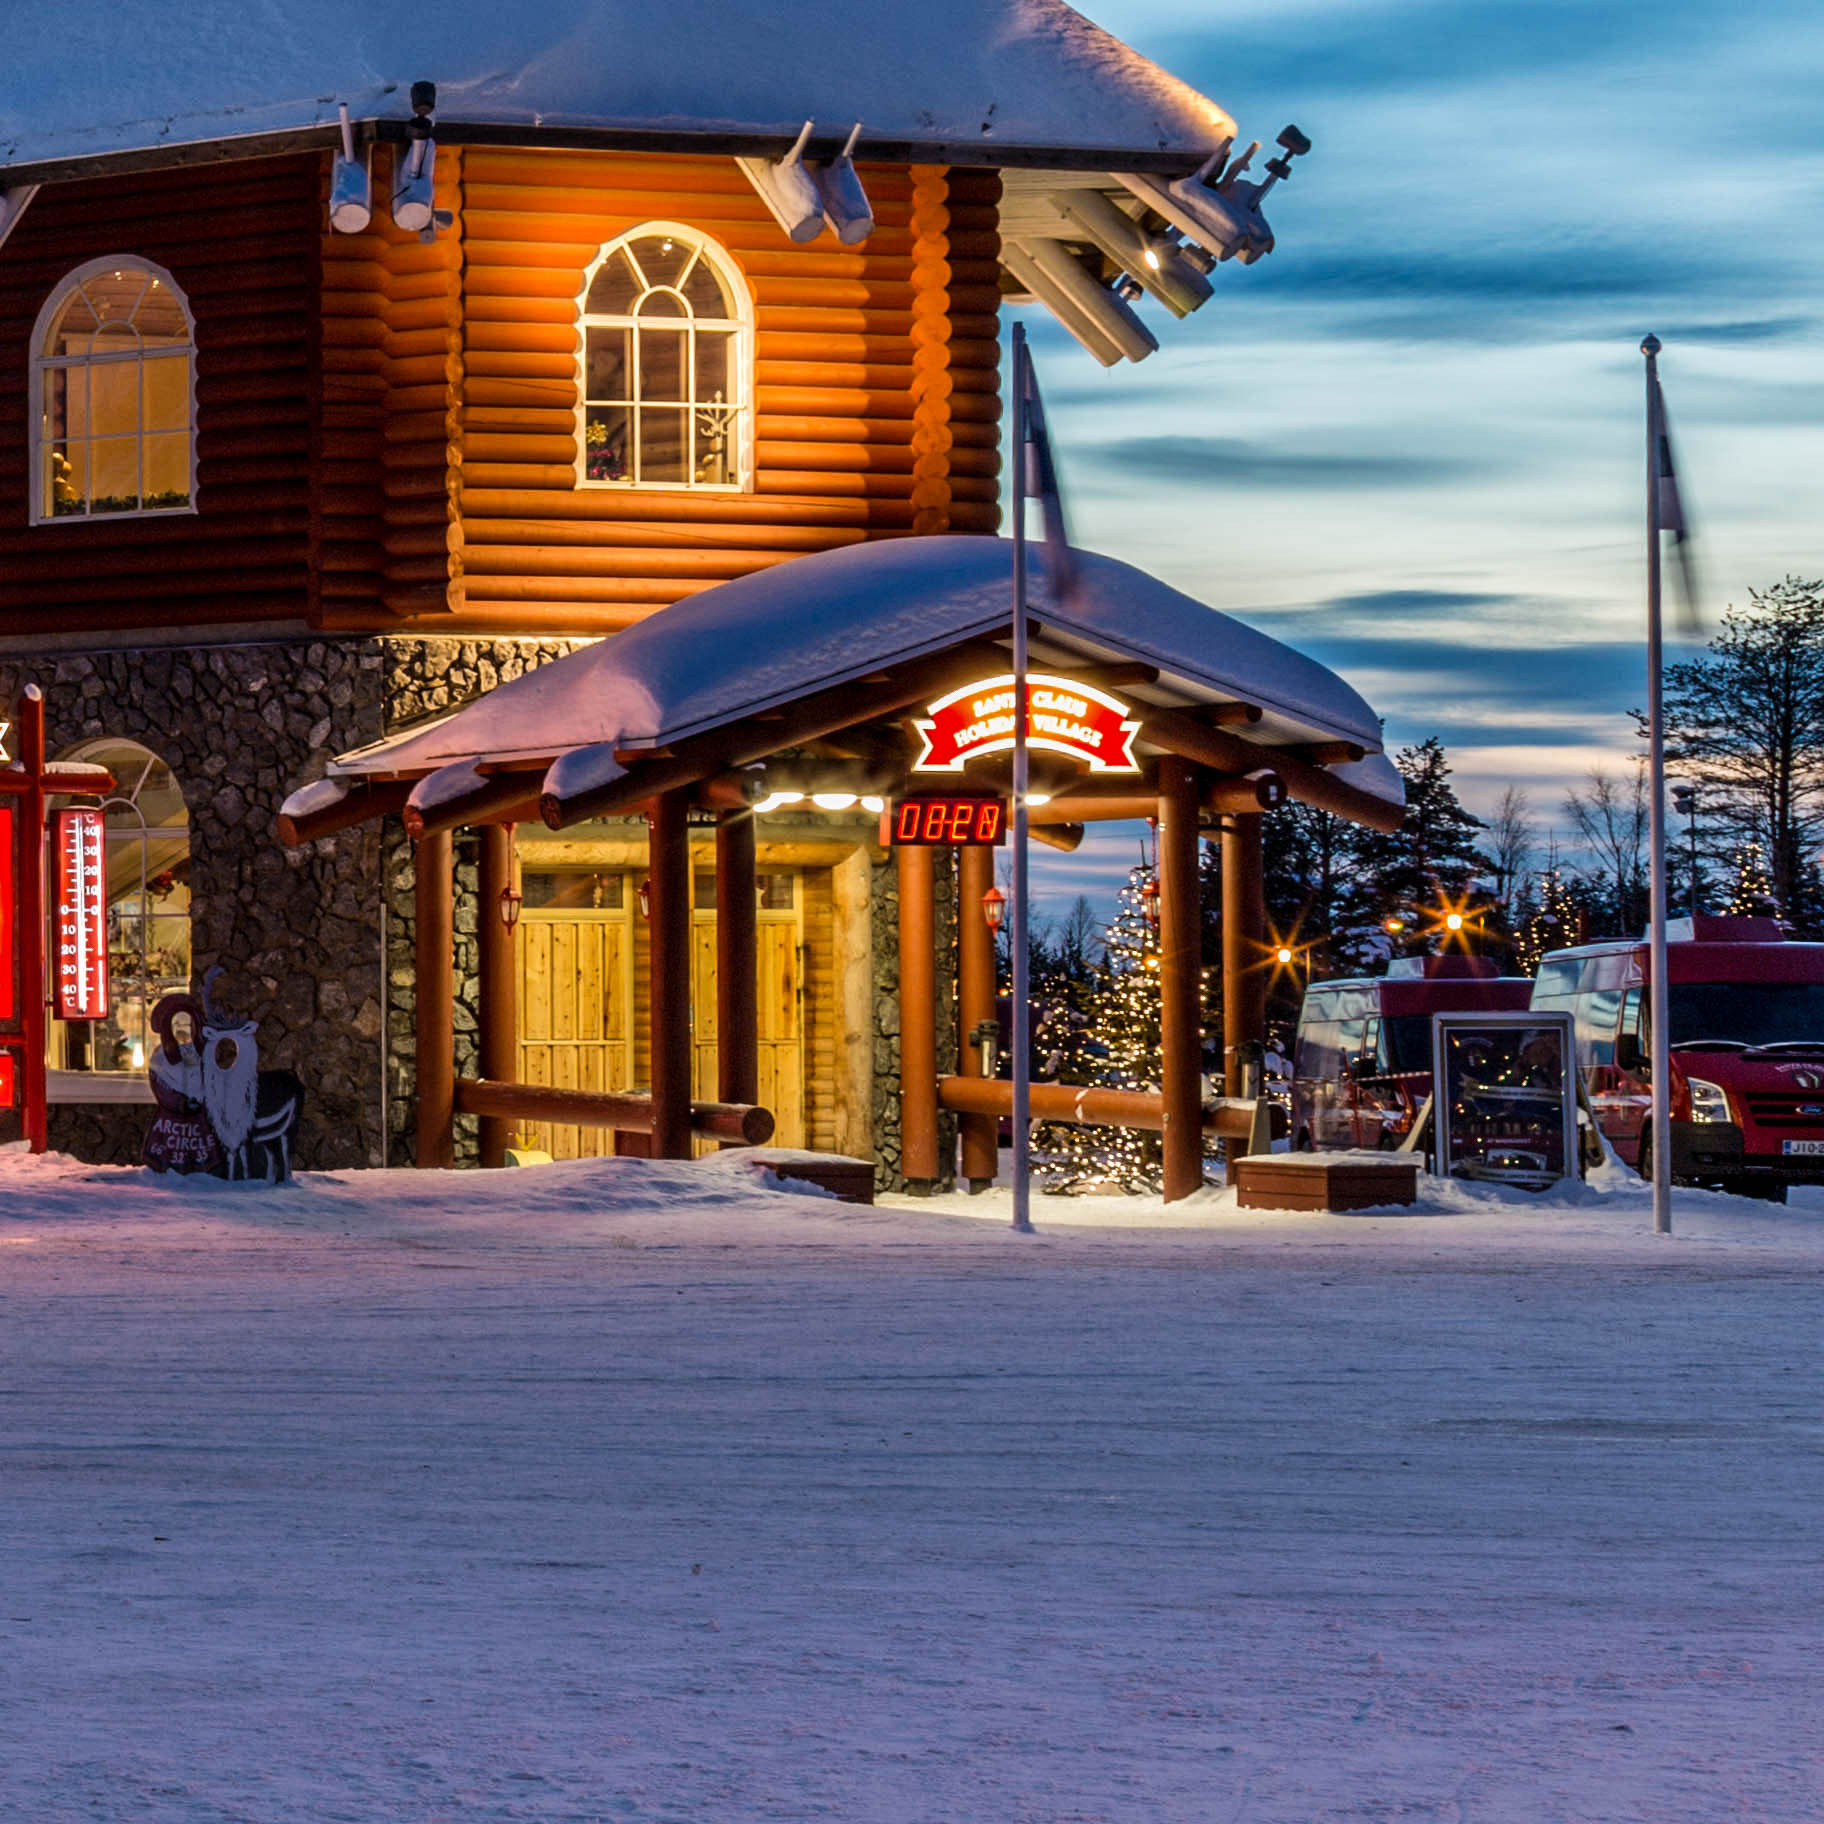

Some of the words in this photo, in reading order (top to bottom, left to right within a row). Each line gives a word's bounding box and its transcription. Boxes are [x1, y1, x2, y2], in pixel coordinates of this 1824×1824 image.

[972, 692, 1016, 717] SANT
[1032, 690, 1088, 718] CLAUS
[953, 714, 1016, 748] HOLIDA
[1032, 713, 1103, 748] VILLAGE
[83, 827, 97, 836] 40
[84, 846, 97, 856] 30
[84, 866, 97, 875] 20
[85, 886, 98, 895] 10
[62, 925, 76, 935] 10
[61, 945, 76, 954] 20
[62, 965, 76, 974] 30
[62, 985, 77, 994] 40
[153, 1119, 201, 1137] ARCTIC
[167, 1134, 216, 1150] CIRCLE
